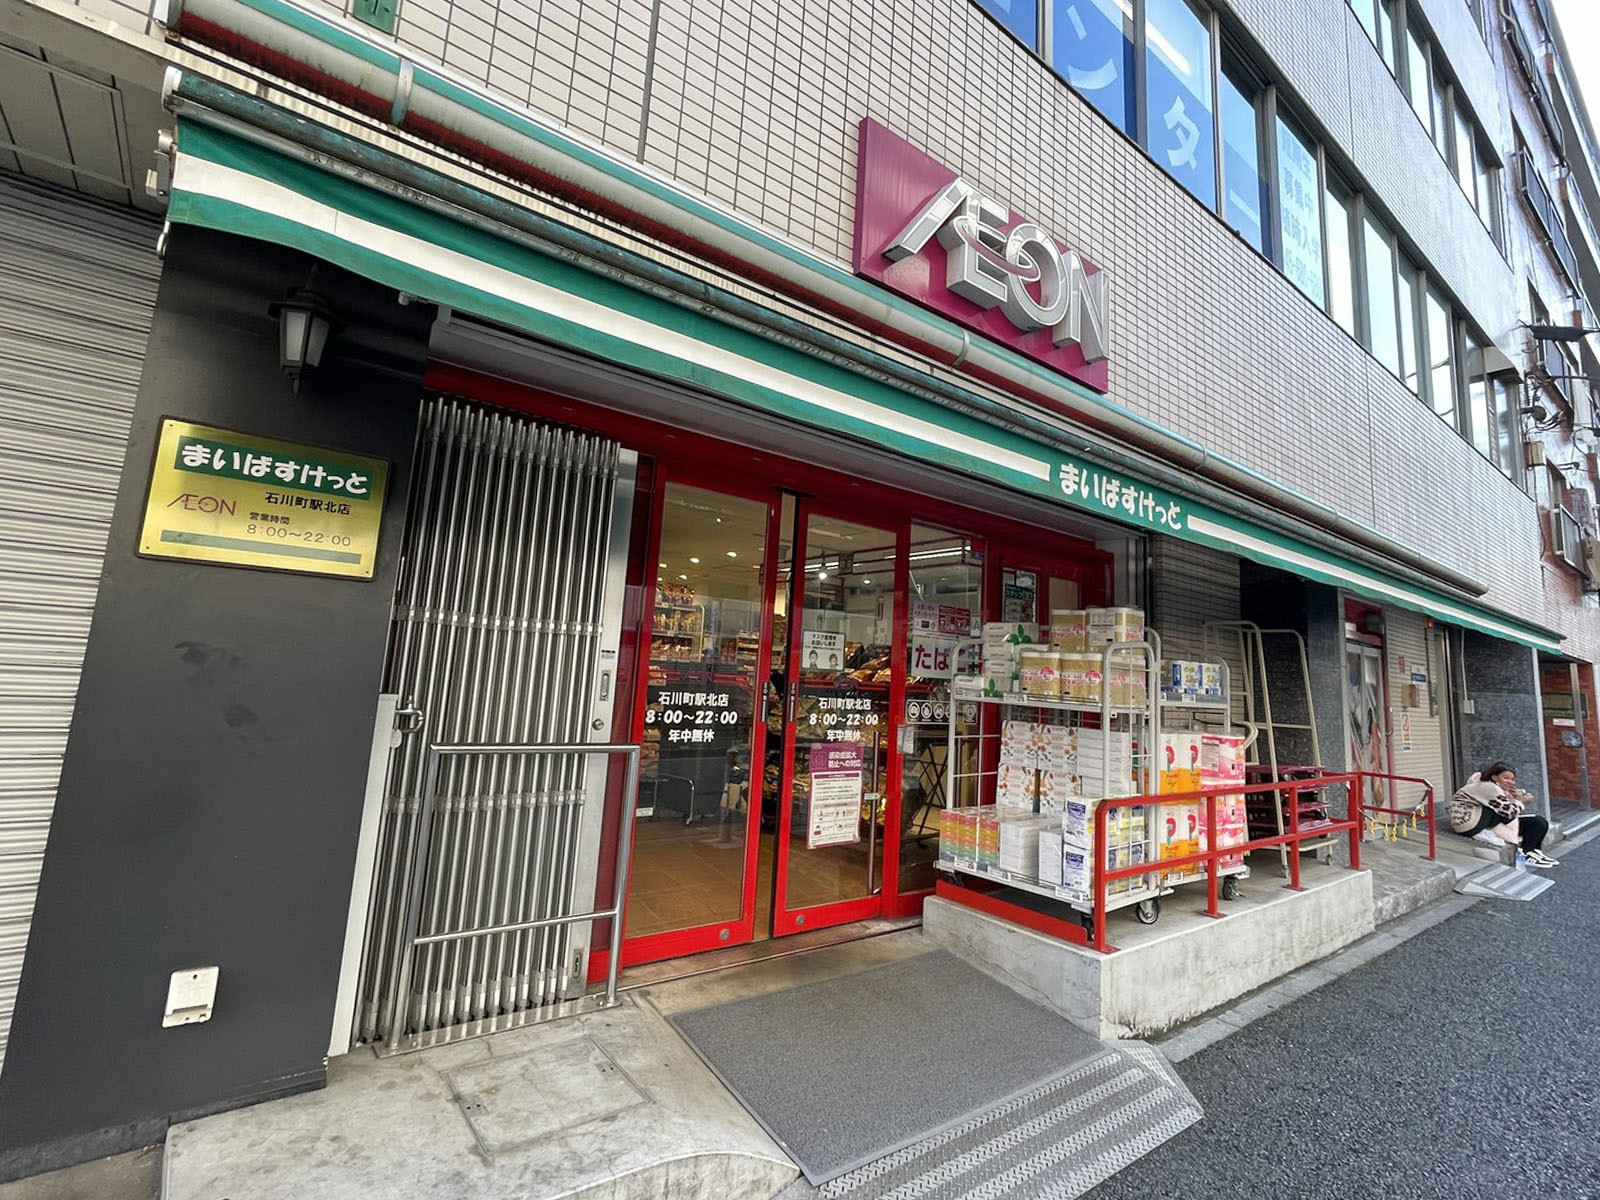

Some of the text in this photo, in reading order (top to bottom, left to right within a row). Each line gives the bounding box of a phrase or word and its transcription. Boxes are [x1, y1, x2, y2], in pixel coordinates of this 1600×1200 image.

[181, 443, 369, 495] まいばすけっと
[265, 492, 351, 516] 石川町駅北店
[1059, 463, 1182, 530] まいばすけっと
[249, 512, 290, 525] 営業時間
[246, 523, 351, 547] 8:00～22:00
[658, 691, 730, 707] 石川町駅北店
[818, 698, 872, 711] 石川町駅北店
[645, 710, 738, 725] 8:00～22:00
[809, 713, 879, 726] 8:00～22:00
[668, 728, 715, 743] 年中無休
[826, 728, 862, 742] 年中無休
